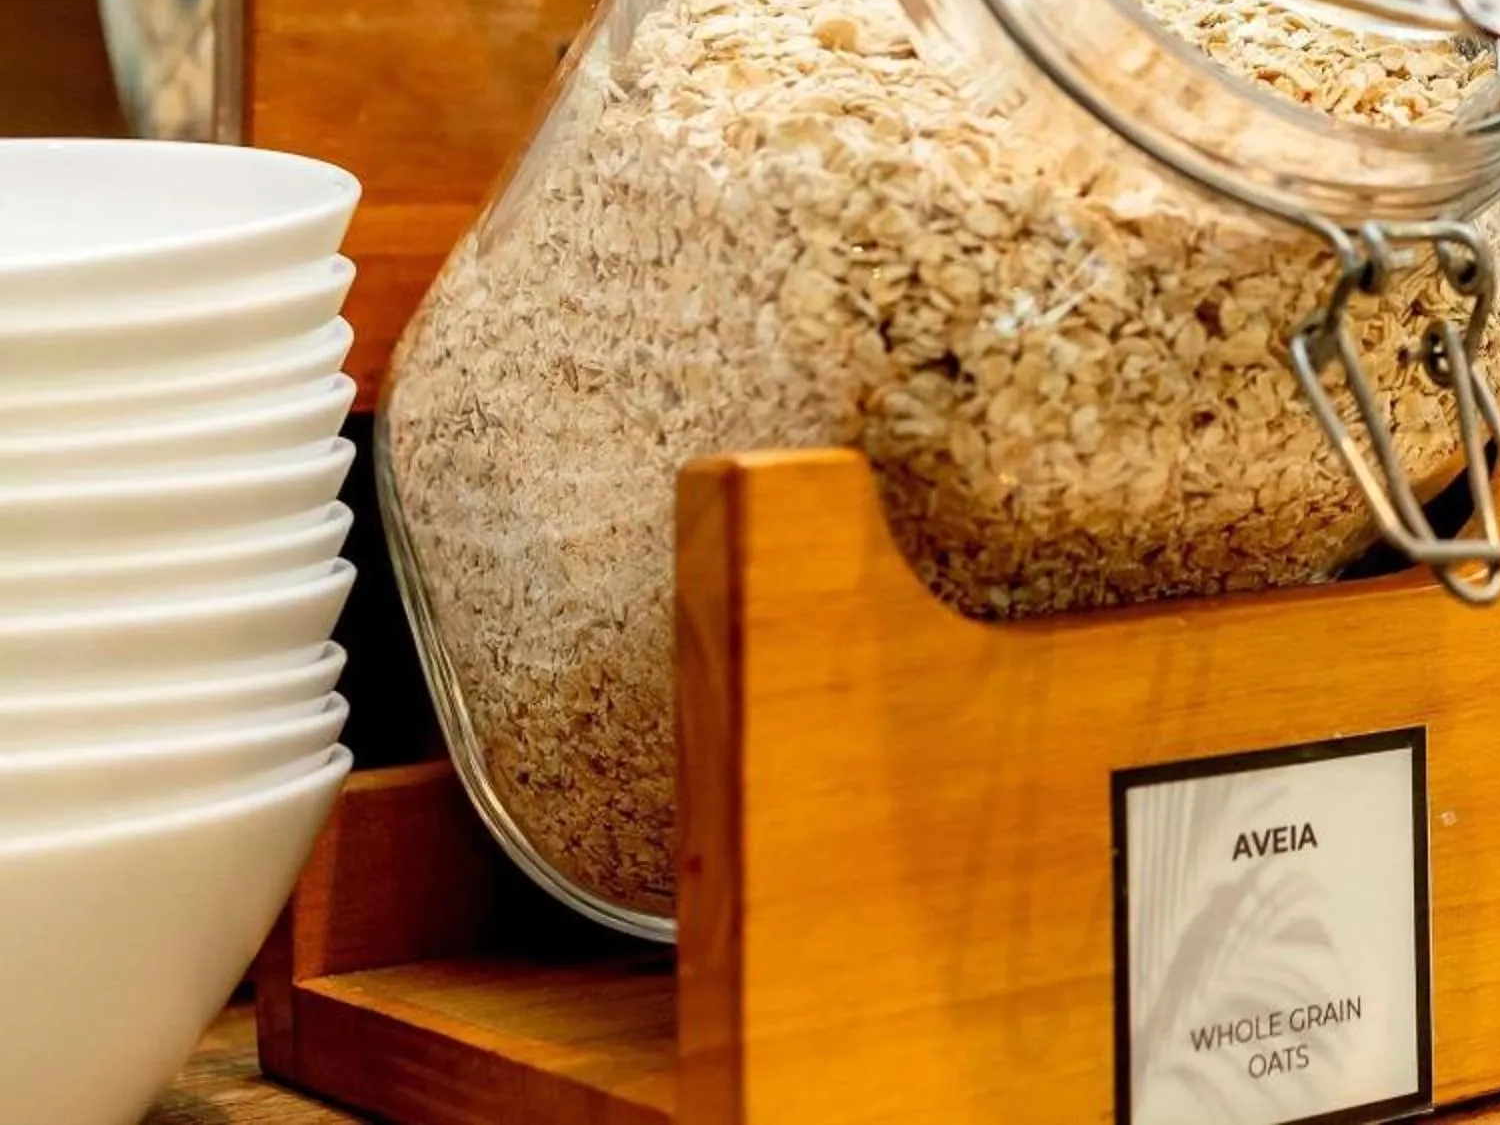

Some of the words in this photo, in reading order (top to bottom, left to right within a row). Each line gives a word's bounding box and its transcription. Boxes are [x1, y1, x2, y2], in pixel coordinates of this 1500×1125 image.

[1232, 822, 1318, 861] AVEIA
[1190, 1011, 1282, 1052] WHOLE
[1289, 996, 1363, 1034] GRAIN
[1248, 1044, 1310, 1079] OATS
